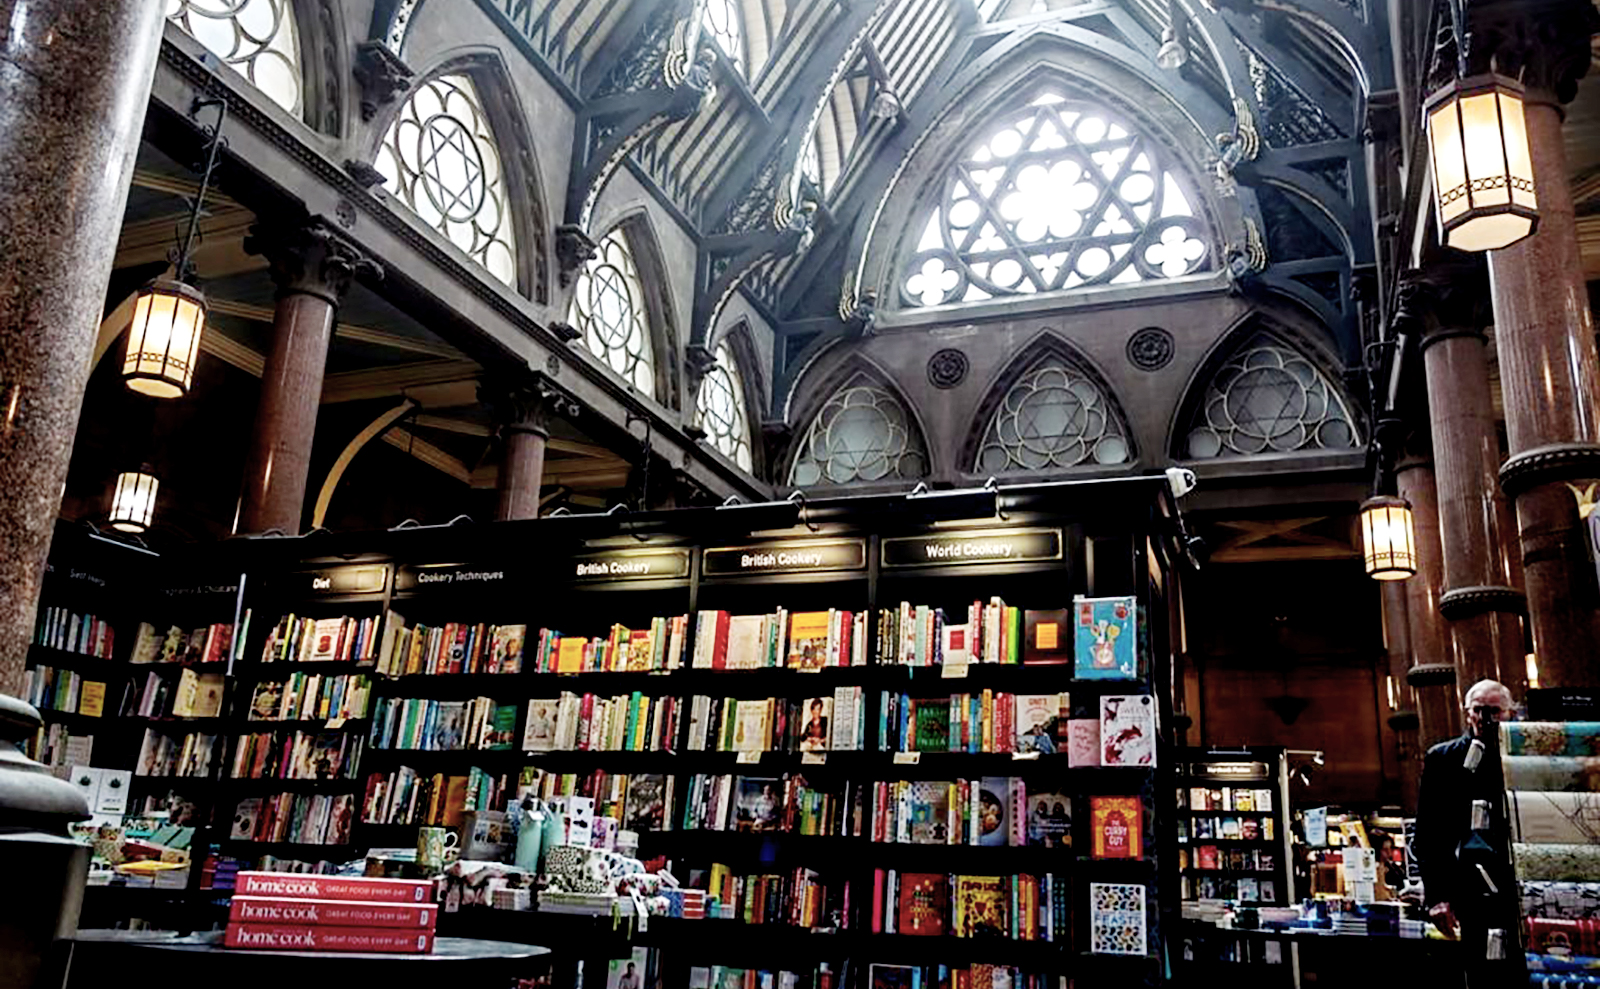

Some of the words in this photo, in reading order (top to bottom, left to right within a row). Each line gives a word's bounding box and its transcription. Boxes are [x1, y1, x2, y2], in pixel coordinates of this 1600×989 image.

[926, 544, 962, 558] World
[963, 542, 1012, 557] Cookery
[741, 553, 776, 567] British
[778, 552, 822, 566] Cookery
[576, 563, 609, 575] British
[610, 561, 651, 574] Cookery
[312, 578, 331, 589] Diet
[418, 572, 453, 583] Cookery
[455, 571, 504, 581] Techniques
[1105, 826, 1127, 836] CURRY
[1109, 836, 1123, 846] GUY
[246, 877, 285, 894] home
[286, 881, 319, 896] cook
[326, 884, 348, 893] GREAT
[350, 886, 370, 895] FOOD
[371, 887, 392, 896] EVERY
[241, 902, 281, 918] home
[283, 905, 319, 920] cook
[326, 910, 348, 918] GREAT
[350, 911, 372, 919] FOOD
[374, 911, 395, 920] EVERY
[237, 927, 277, 943] home
[279, 930, 316, 946] cook
[323, 935, 344, 943] GREAT
[348, 936, 369, 944] FOOD
